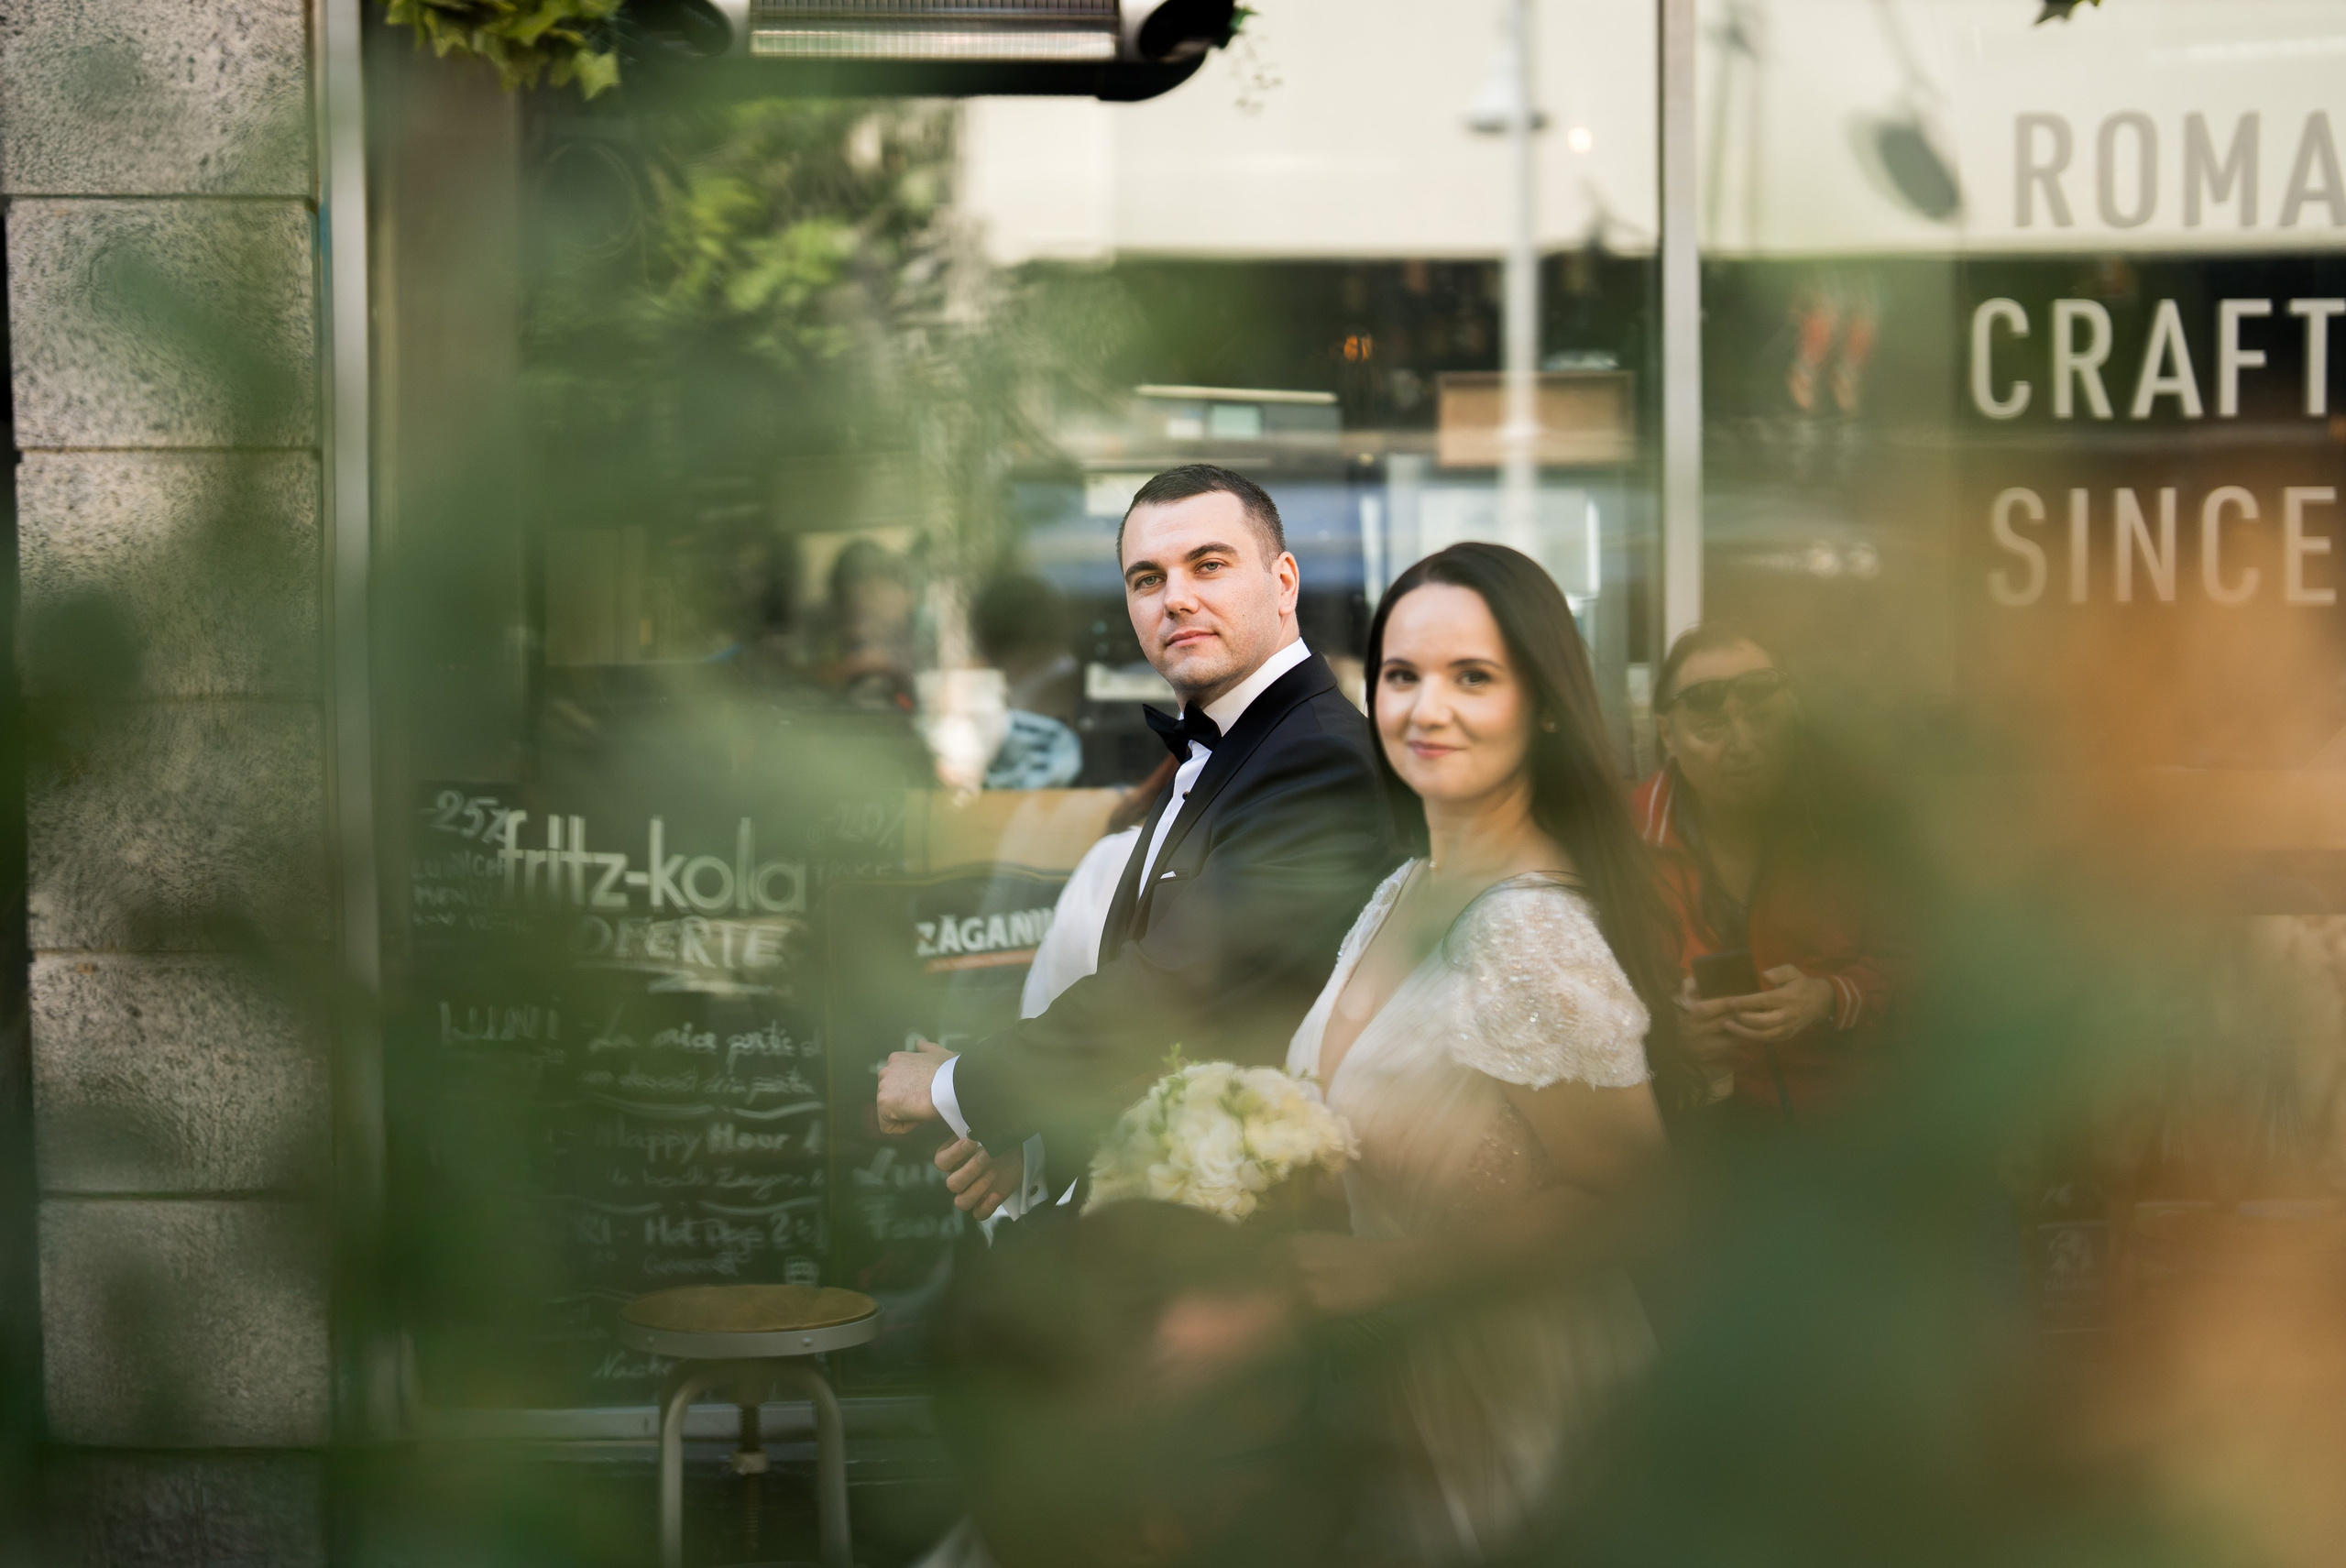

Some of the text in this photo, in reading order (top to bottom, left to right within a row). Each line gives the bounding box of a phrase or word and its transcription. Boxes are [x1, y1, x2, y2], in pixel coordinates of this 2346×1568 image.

[2013, 110, 2346, 229] ROMA
[1971, 298, 2346, 420] CRAFT
[1986, 486, 2338, 606] SINCE
[497, 810, 807, 916] fritz-kola
[566, 915, 792, 970] OFERTE
[595, 1111, 704, 1165] Happy
[707, 1121, 790, 1155] Hour
